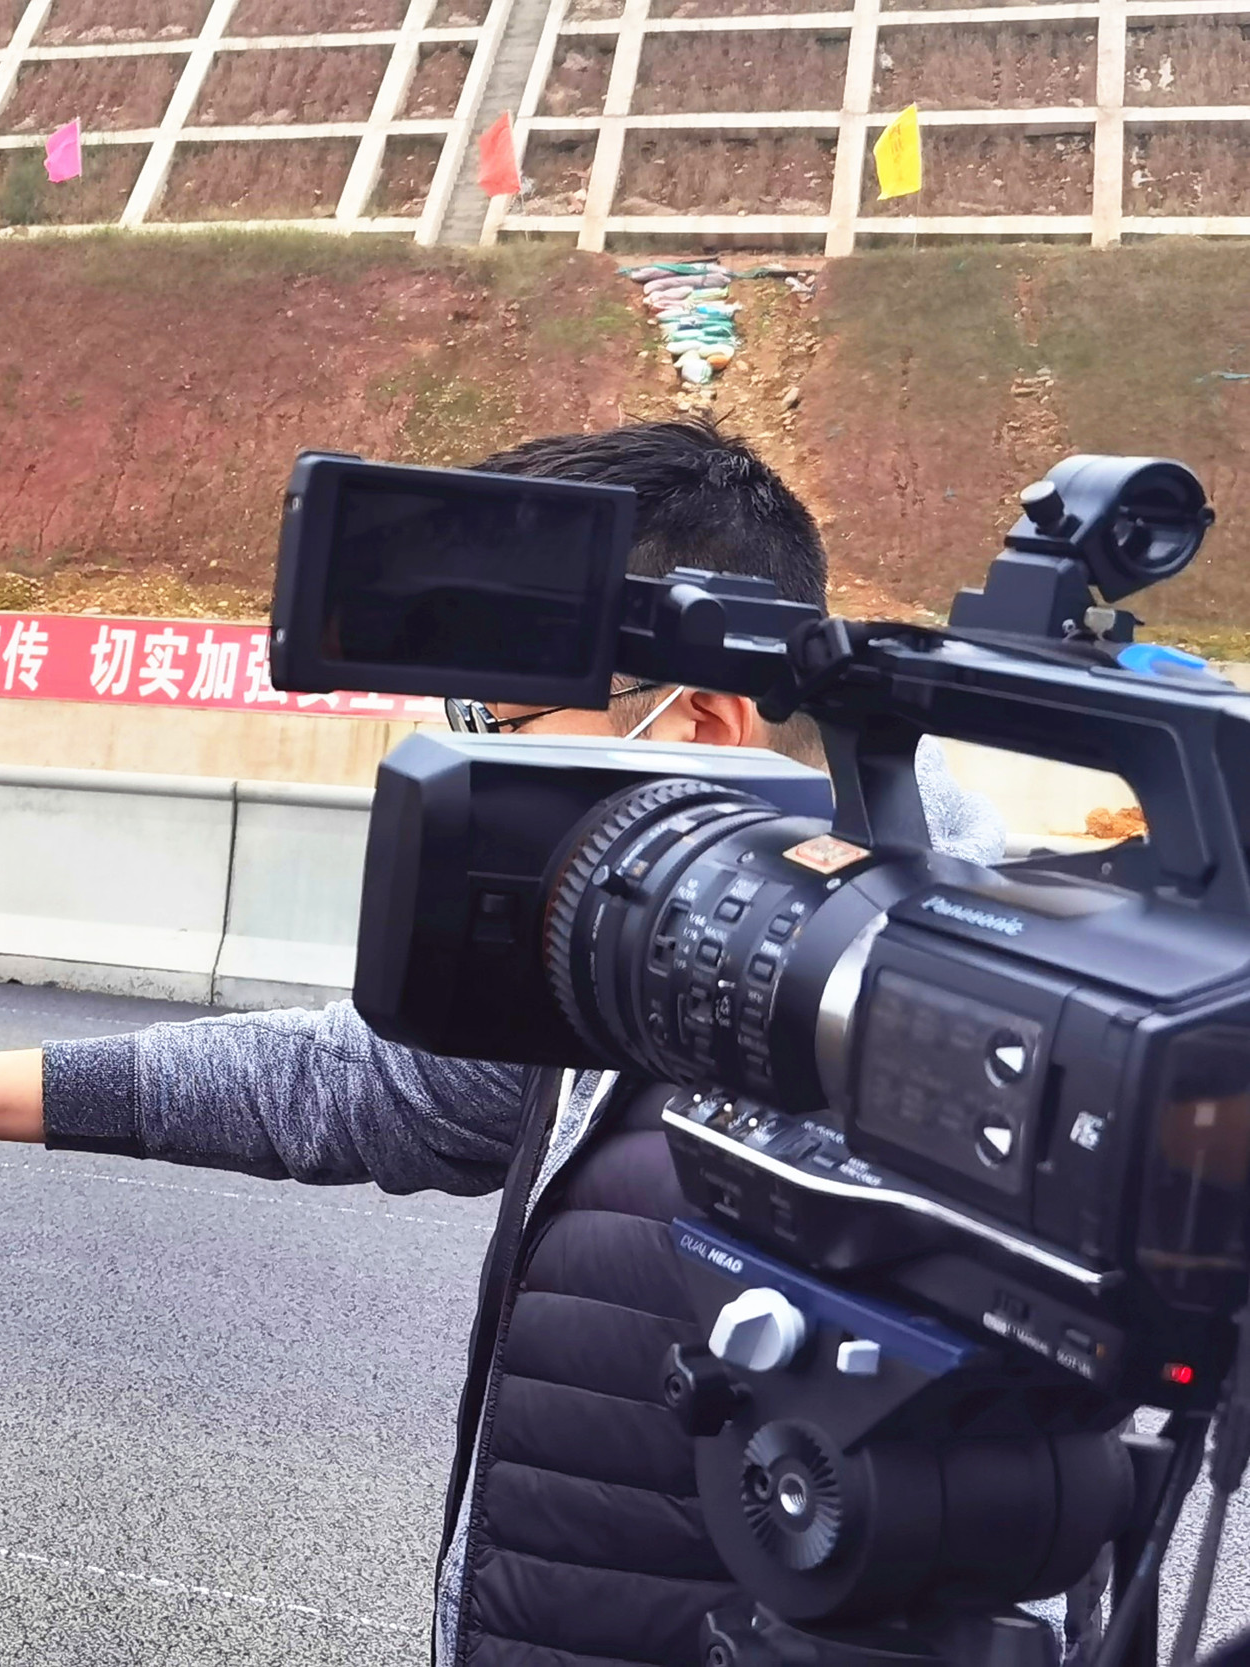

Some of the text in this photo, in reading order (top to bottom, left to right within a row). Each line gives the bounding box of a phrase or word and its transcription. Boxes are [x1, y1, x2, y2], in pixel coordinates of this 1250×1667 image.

[921, 895, 1023, 937] Panasonic
[680, 1234, 743, 1274] DUAL HEAD
